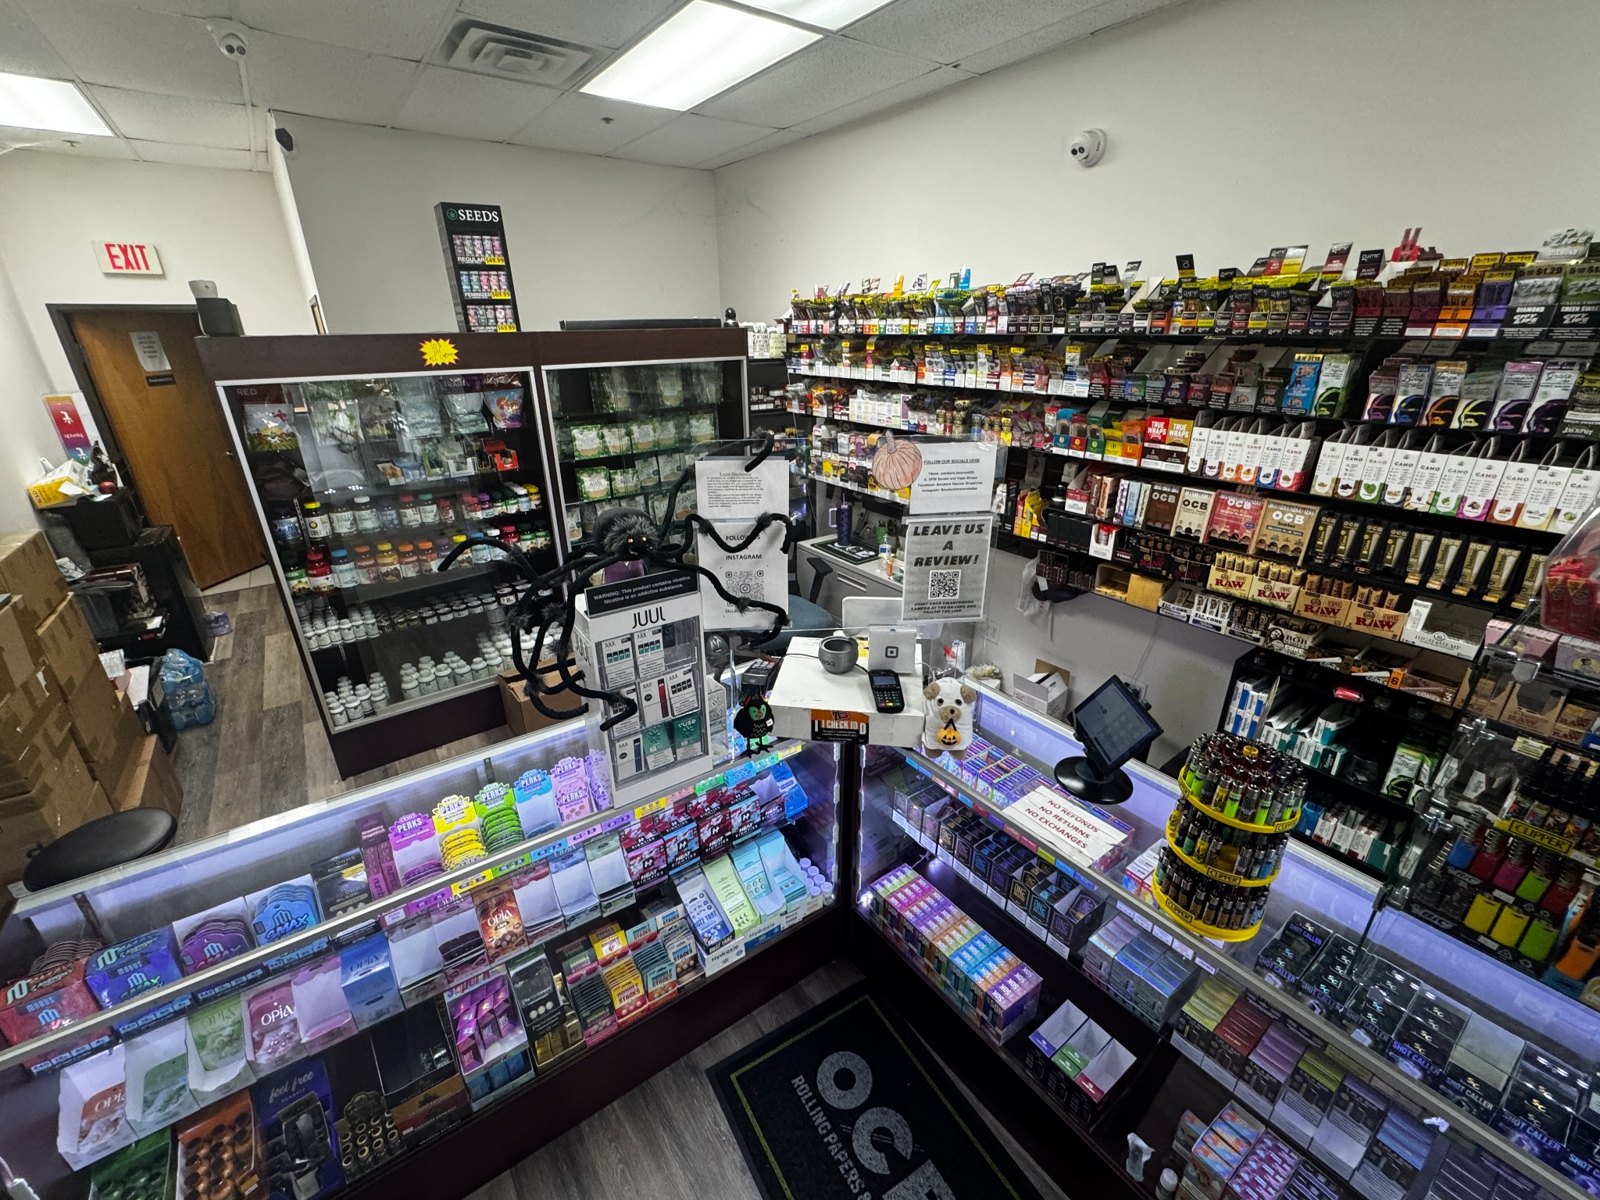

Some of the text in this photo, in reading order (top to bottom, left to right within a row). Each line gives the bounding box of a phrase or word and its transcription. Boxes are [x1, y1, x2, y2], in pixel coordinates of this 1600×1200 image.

[458, 209, 500, 222] SEEDS
[104, 243, 151, 271] EXIT
[1536, 266, 1563, 276] $1.29
[1147, 426, 1168, 436] WRAPS
[1152, 420, 1165, 429] TRUE
[1168, 429, 1189, 438] WRAPS
[1562, 427, 1594, 436] JACKPOT
[1475, 472, 1498, 480] CAMO
[1152, 492, 1176, 504] OCB
[1182, 498, 1208, 510] OCB
[1227, 499, 1252, 510] OCB
[1272, 510, 1305, 526] OCB
[912, 524, 985, 536] LEAVE US
[942, 540, 954, 550] A
[914, 554, 979, 567] REVIEW!
[594, 592, 620, 600] WARNING:
[632, 584, 651, 592] product
[652, 580, 672, 588] contains
[1215, 578, 1245, 590] RAW
[604, 596, 624, 604] Nicotine
[637, 588, 658, 597] addictive
[1258, 590, 1290, 600] RAW
[1304, 604, 1342, 617] RAW
[632, 606, 666, 629] JUUL
[1355, 616, 1398, 631] RAW
[1390, 676, 1399, 686] 6
[1444, 692, 1453, 702] 3
[826, 720, 849, 729] CHECK
[850, 720, 858, 730] ID
[556, 762, 576, 774] PERKS
[520, 774, 542, 787] PERKS
[482, 788, 504, 802] PERKS
[562, 790, 584, 802] PERKS
[440, 801, 465, 814] PERKS
[1039, 806, 1091, 839] NO RETURNS
[1048, 800, 1100, 833] NO REFUNDS
[397, 818, 422, 833] PERKS
[738, 822, 754, 834] HEAT
[1025, 808, 1088, 850] NO EXCHANGES
[708, 835, 724, 848] HEAT
[1514, 822, 1566, 850] CLIPPER
[676, 851, 692, 862] HEAT
[641, 868, 657, 880] HEAT
[1209, 870, 1240, 884] CLIPPER
[1013, 886, 1027, 898] ONE
[1167, 900, 1192, 921] CLIPPER
[749, 922, 776, 938] Hydroxie
[1302, 929, 1322, 945] CALLER
[712, 944, 739, 962] Hydroxie
[1274, 964, 1296, 983] CALLER
[1392, 1040, 1441, 1075] SHOT CALLER
[270, 1071, 314, 1104] feel free
[1446, 1078, 1494, 1111] SHOT CALLER
[791, 1075, 866, 1193] ROLLING PAPERS
[1503, 1111, 1562, 1152] SHOT CALLER
[1568, 1153, 1592, 1172] SHOT
